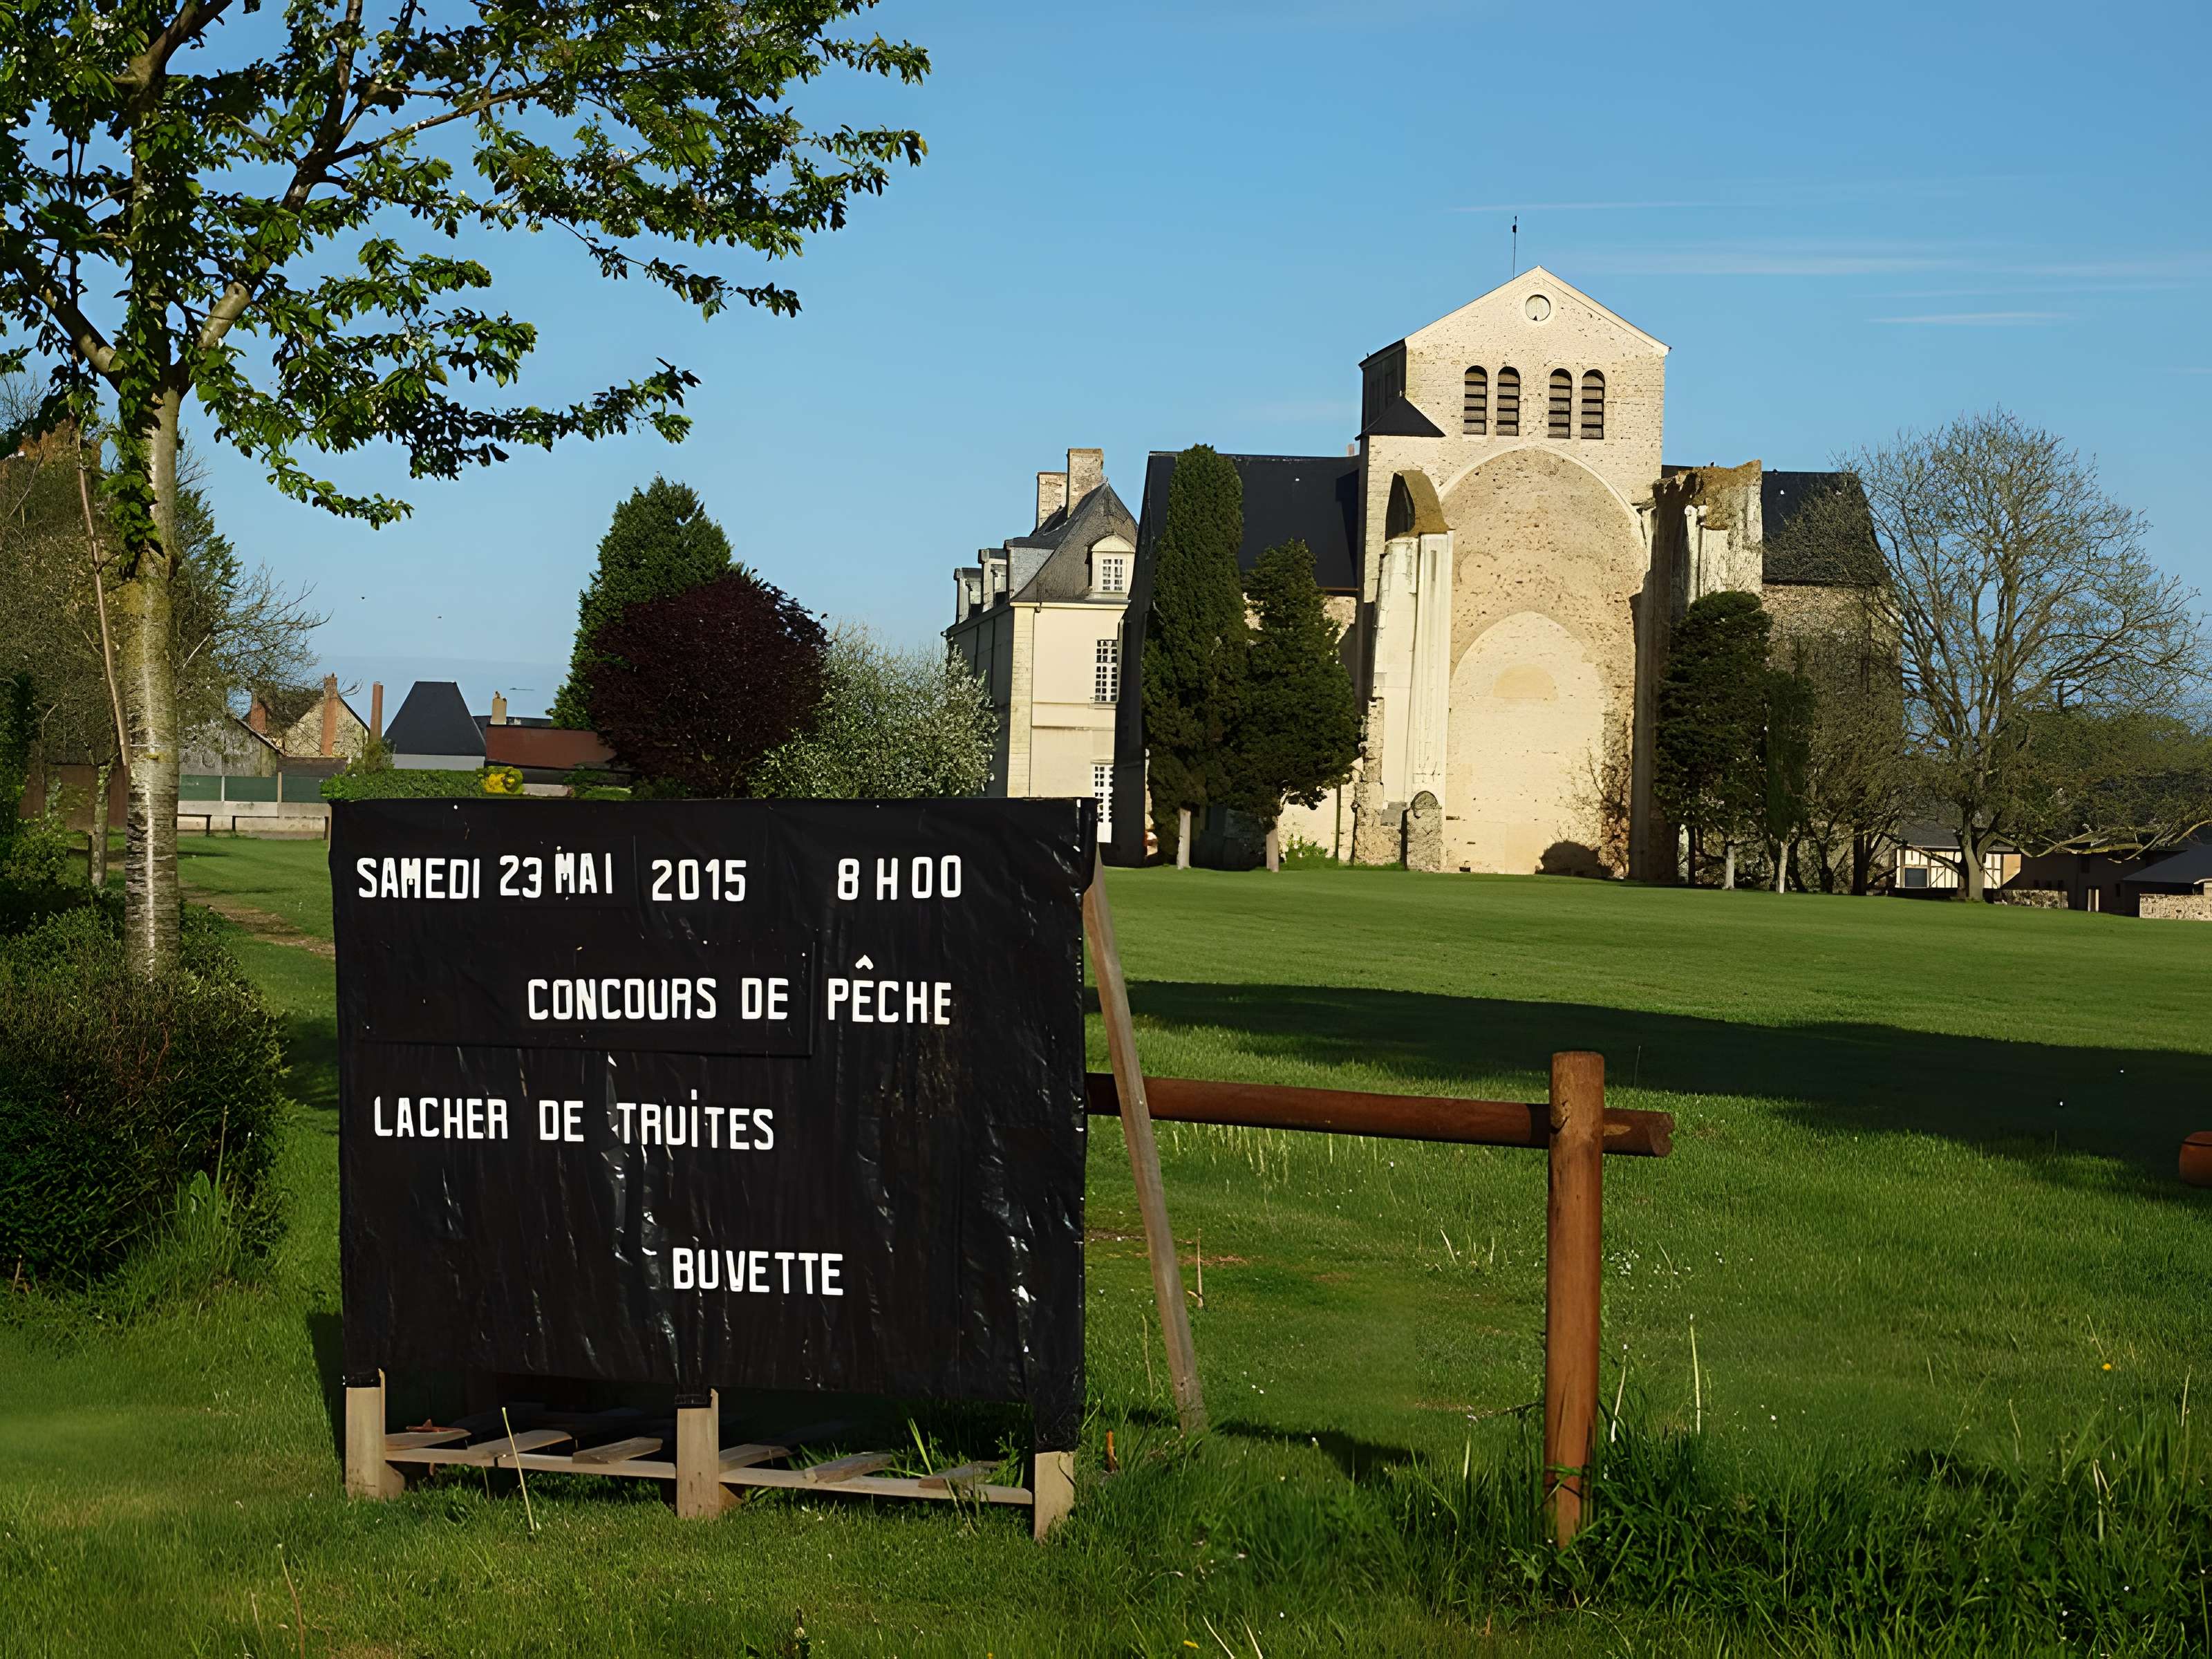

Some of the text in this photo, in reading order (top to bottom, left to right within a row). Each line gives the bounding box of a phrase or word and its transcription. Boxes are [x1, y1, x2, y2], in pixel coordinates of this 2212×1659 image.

[357, 856, 480, 900] SAMEDI
[499, 854, 543, 899] 23
[555, 852, 613, 896] MAI
[650, 859, 747, 903] 2015
[527, 954, 953, 1026] CONCOURS DE PÊCHE
[373, 1096, 509, 1140] LACHER
[538, 1099, 585, 1143] DE
[672, 1247, 844, 1296] BUVETTE
